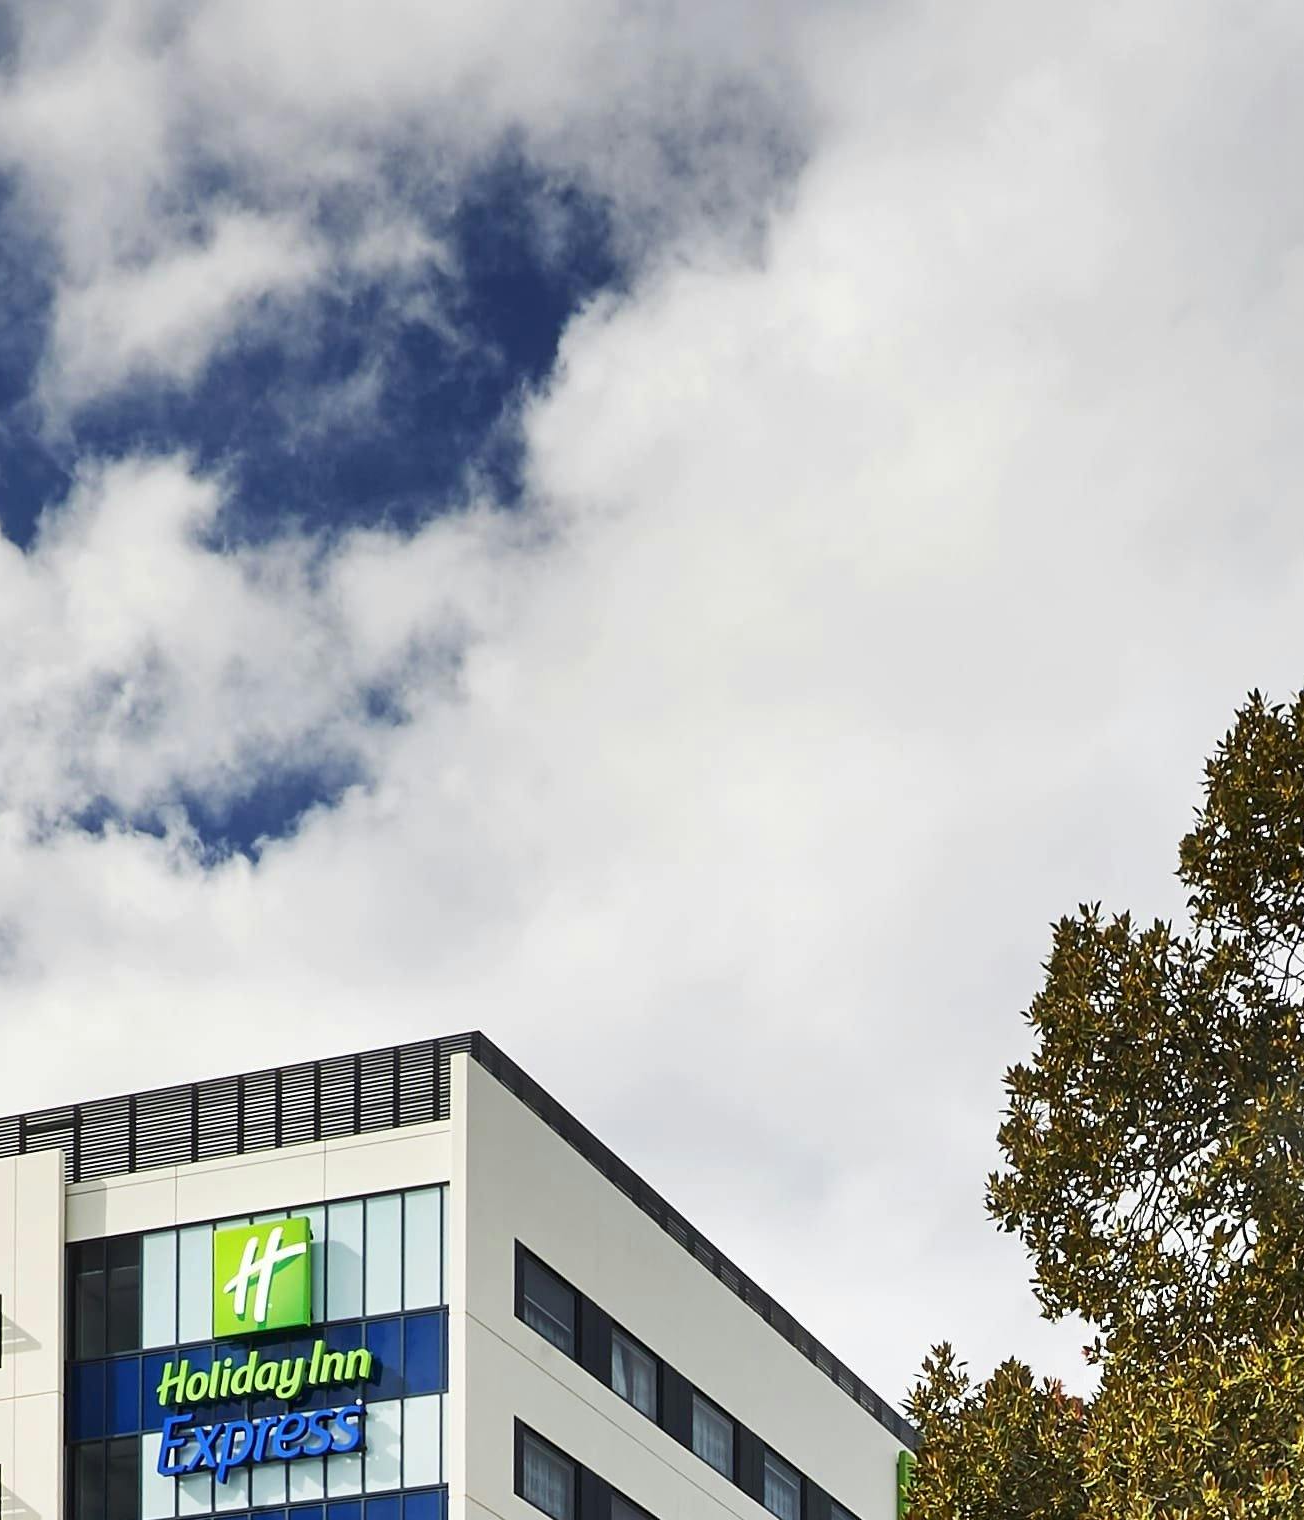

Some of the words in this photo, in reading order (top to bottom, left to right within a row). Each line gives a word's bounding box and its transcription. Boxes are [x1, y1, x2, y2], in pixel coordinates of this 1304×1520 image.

[156, 1351, 304, 1406] Holiday
[308, 1340, 373, 1385] Inn
[156, 1404, 367, 1484] Express
